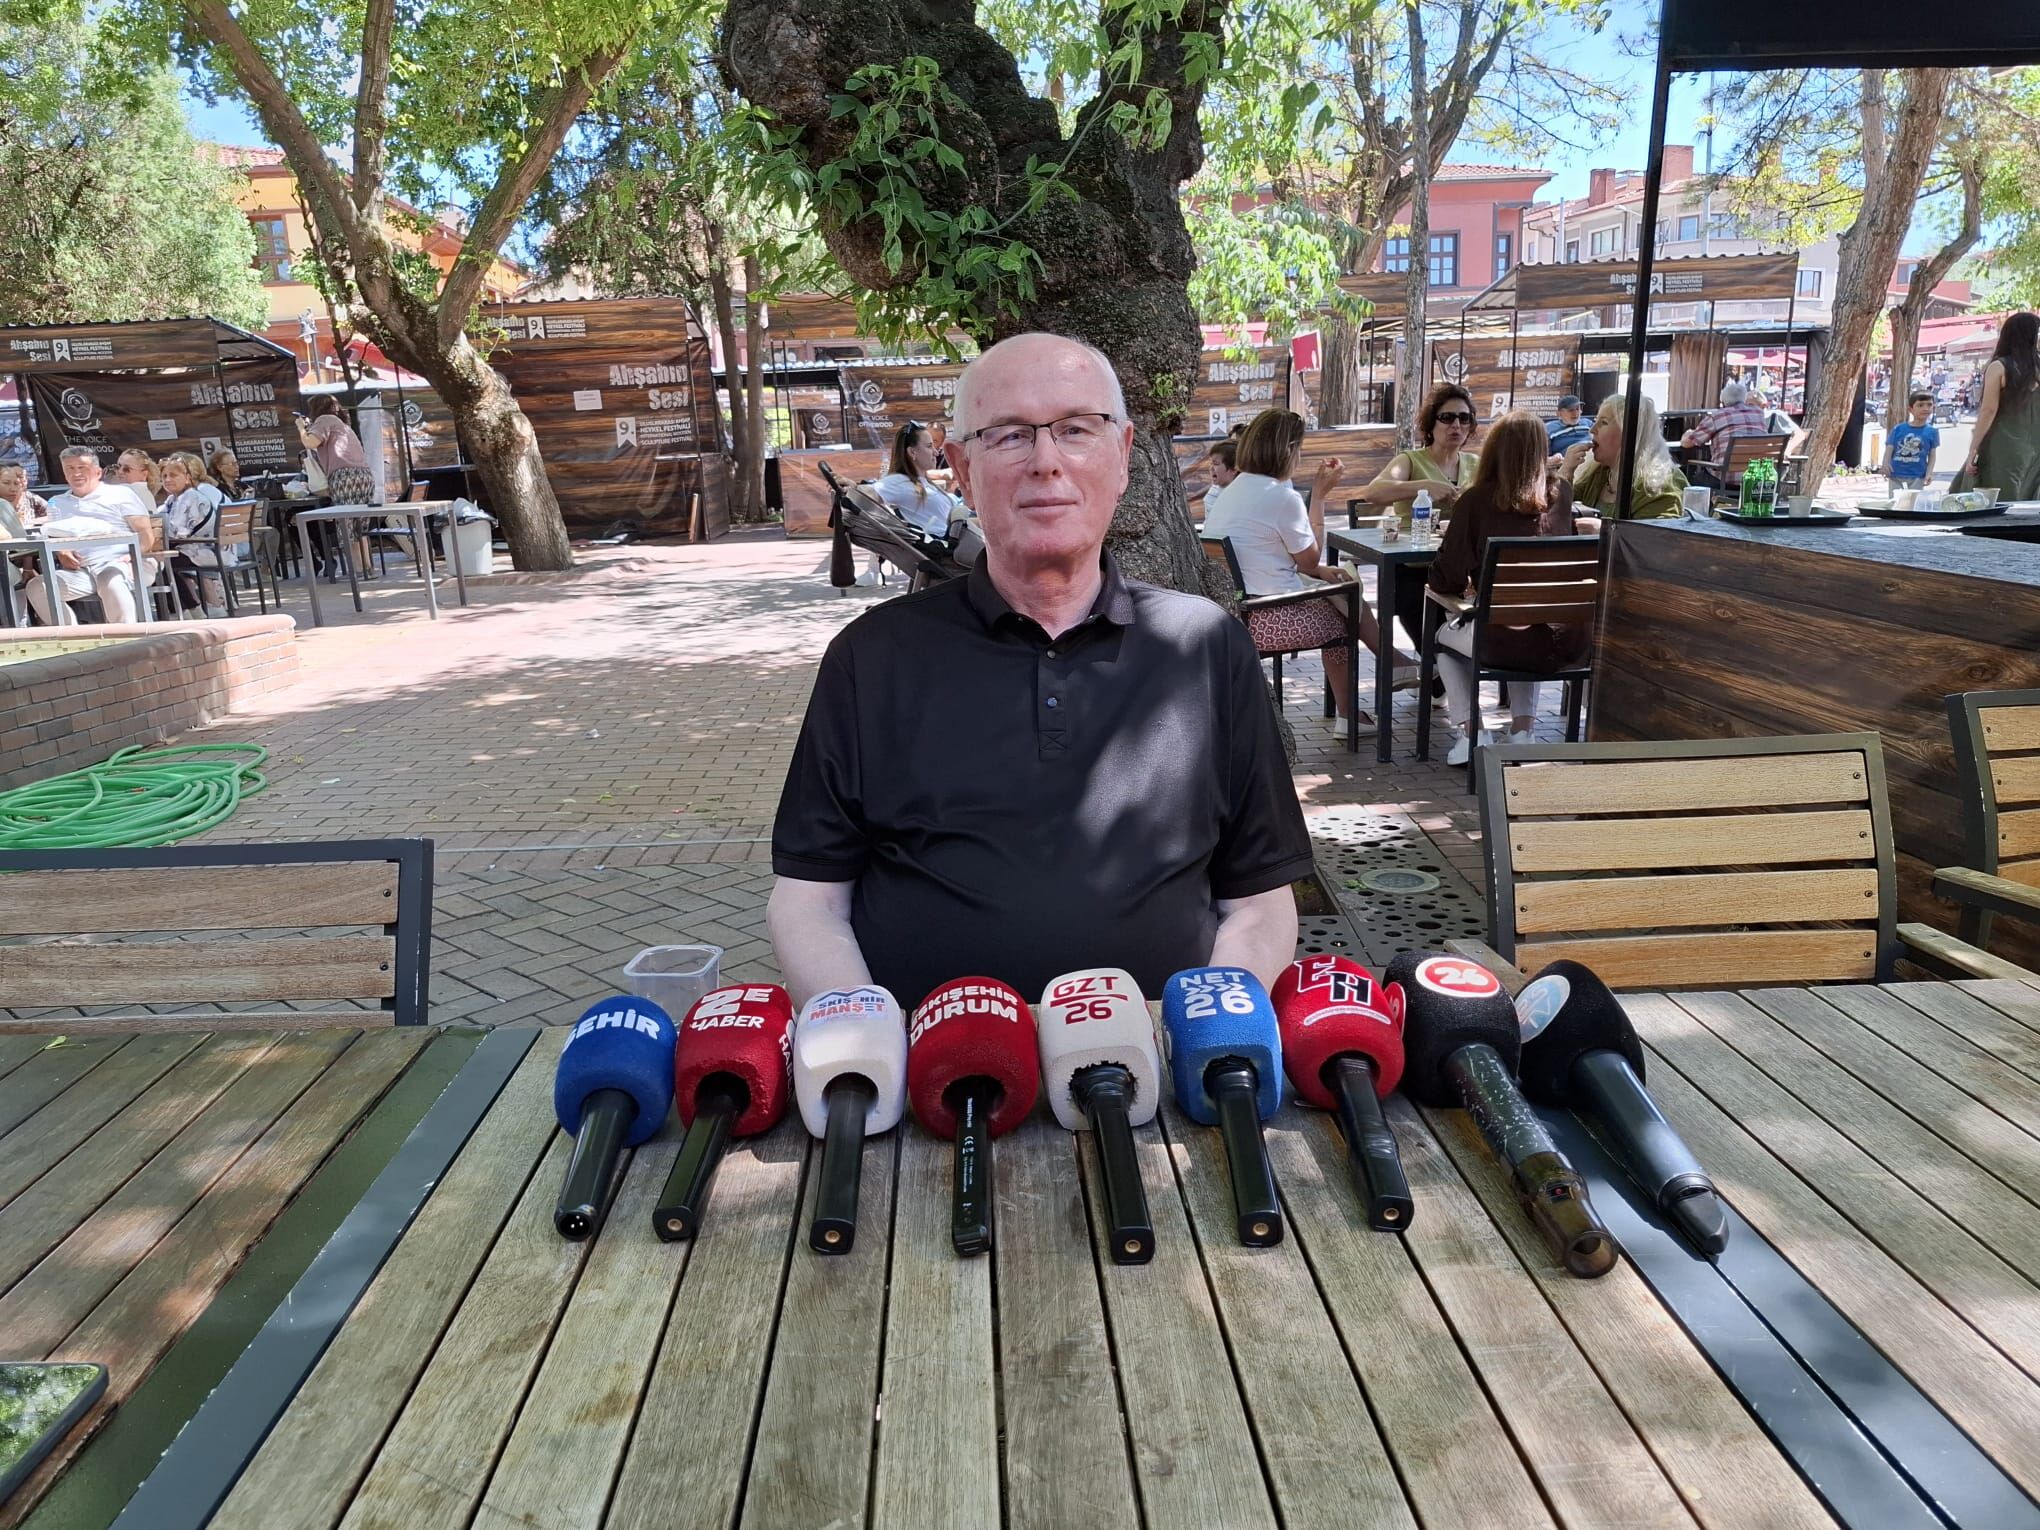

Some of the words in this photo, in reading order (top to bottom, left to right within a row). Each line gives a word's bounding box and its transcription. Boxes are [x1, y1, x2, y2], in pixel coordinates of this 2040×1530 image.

[1610, 273, 1637, 285] Ahşab
[29, 351, 51, 361] Sesi
[609, 363, 688, 388] Ahşabın
[1525, 368, 1561, 388] Sesi
[648, 386, 689, 410] Sesi
[912, 378, 957, 399] Ahşa
[1240, 383, 1273, 402] Sesi
[232, 406, 280, 430] Sesi
[618, 421, 634, 435] 9.
[1212, 412, 1225, 424] 9.
[1179, 972, 1245, 989] NET
[1434, 967, 1489, 986] 26
[1053, 976, 1119, 999] GZT
[1065, 1000, 1113, 1025] 26
[1184, 991, 1255, 1019] 26
[689, 1015, 765, 1031] HABER
[910, 999, 1018, 1048] DURUM
